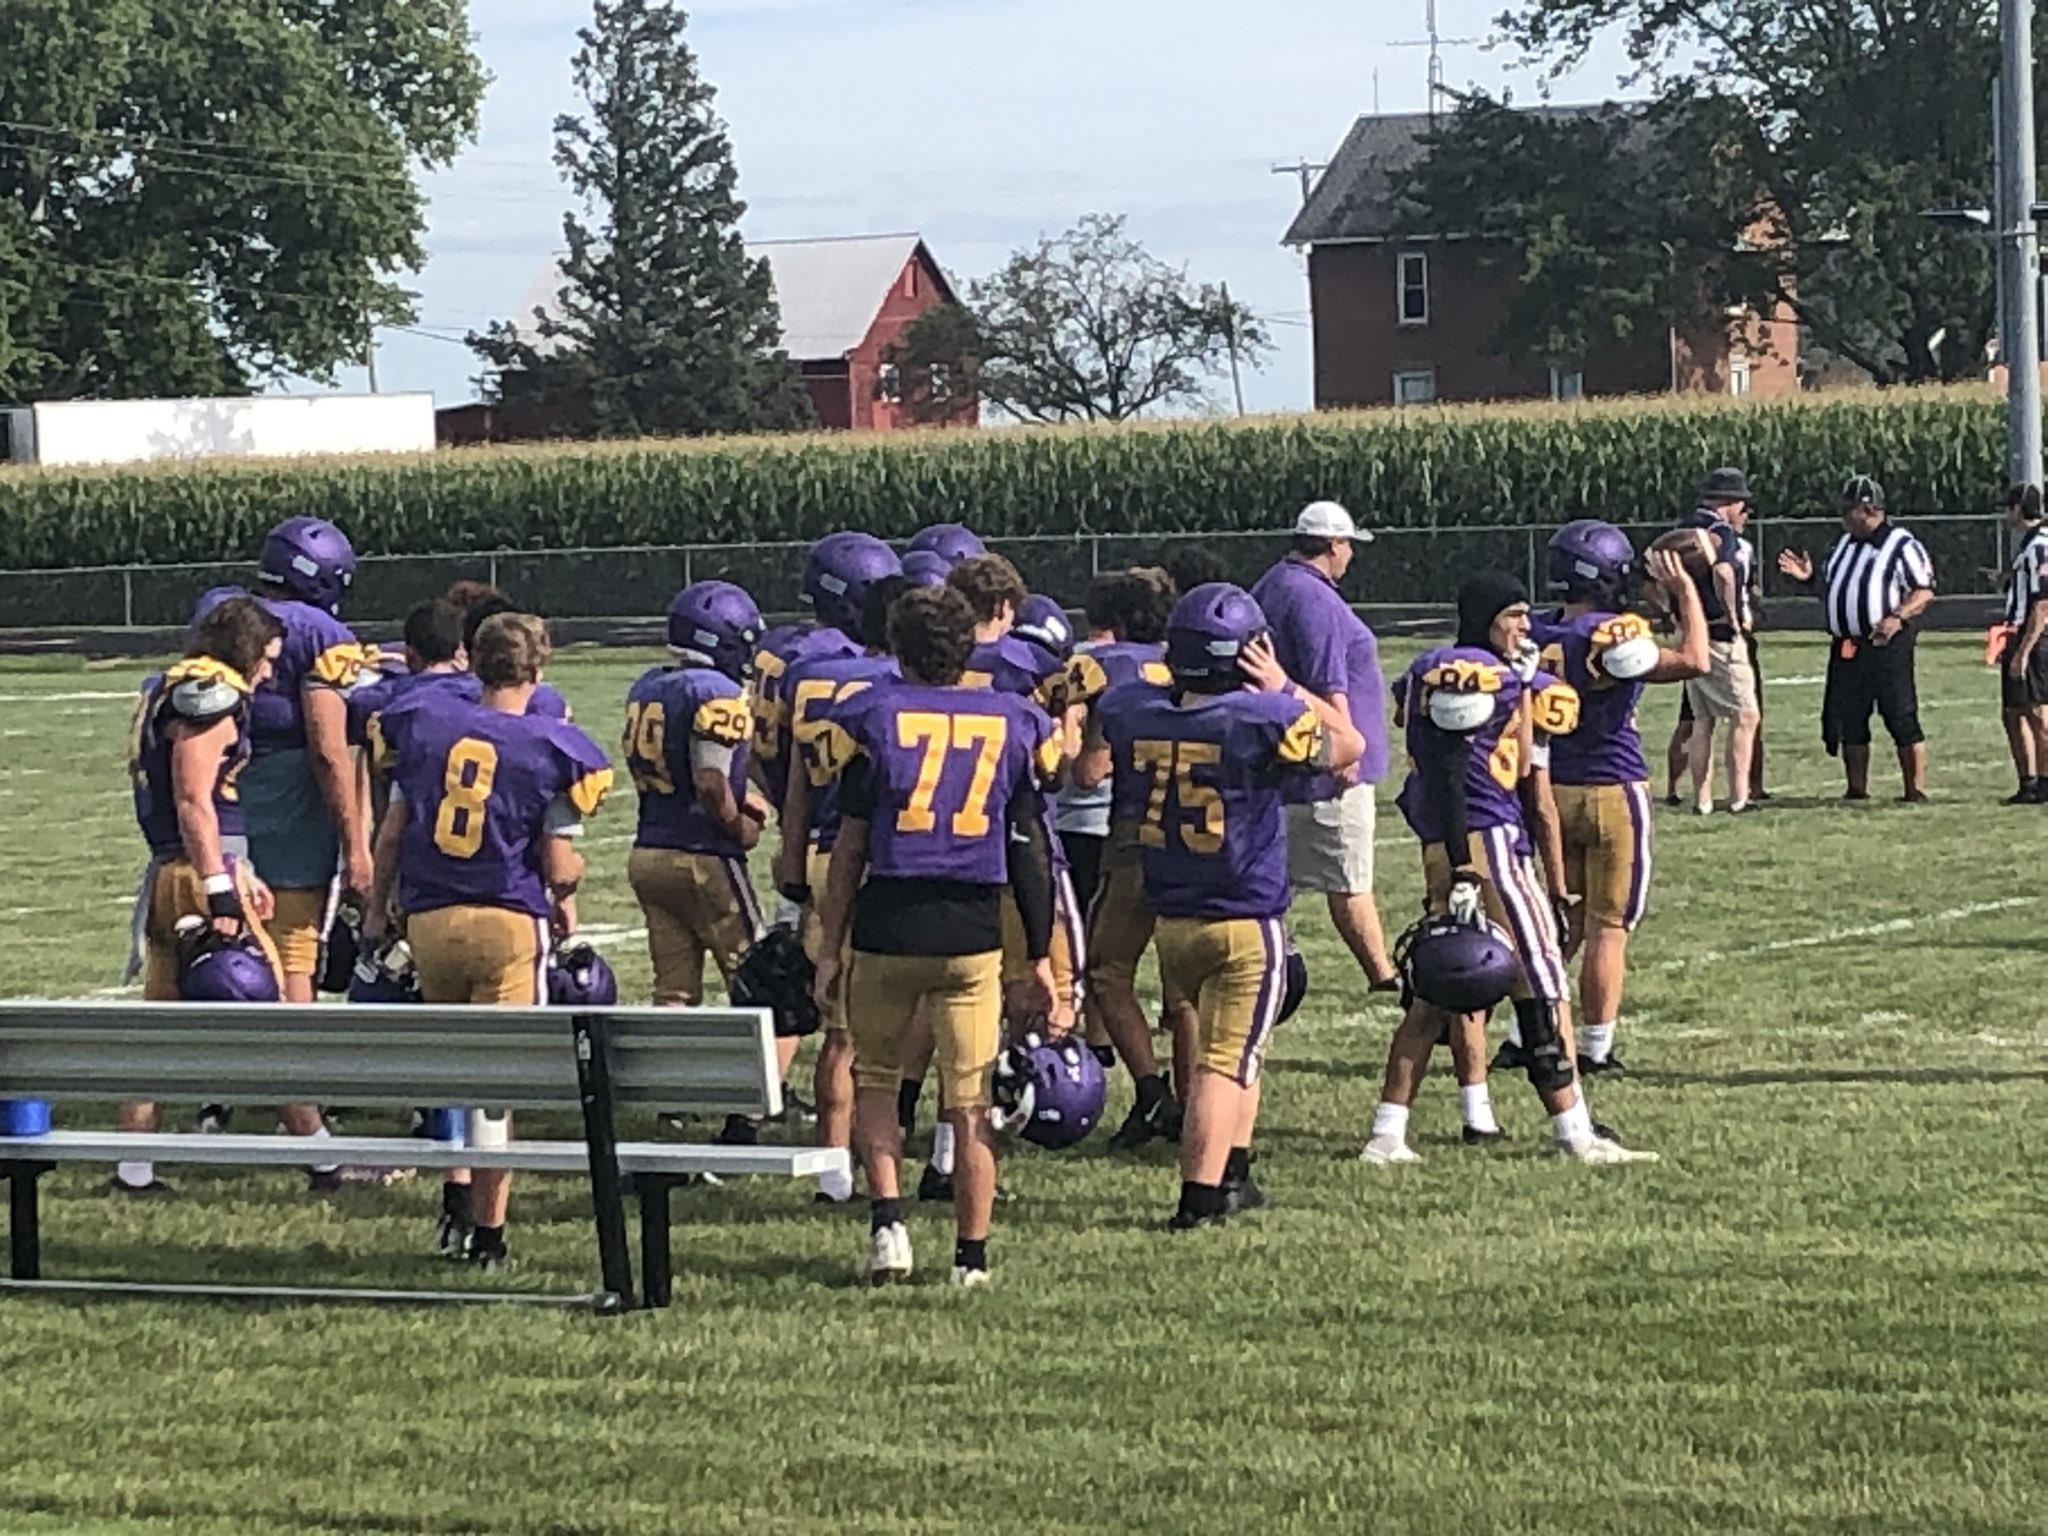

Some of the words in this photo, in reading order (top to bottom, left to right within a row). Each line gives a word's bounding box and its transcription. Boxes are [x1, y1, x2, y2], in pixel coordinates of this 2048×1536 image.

[710, 708, 748, 737] 29
[896, 711, 1008, 838] 77
[433, 736, 499, 860] 8
[1132, 740, 1226, 854] 75
